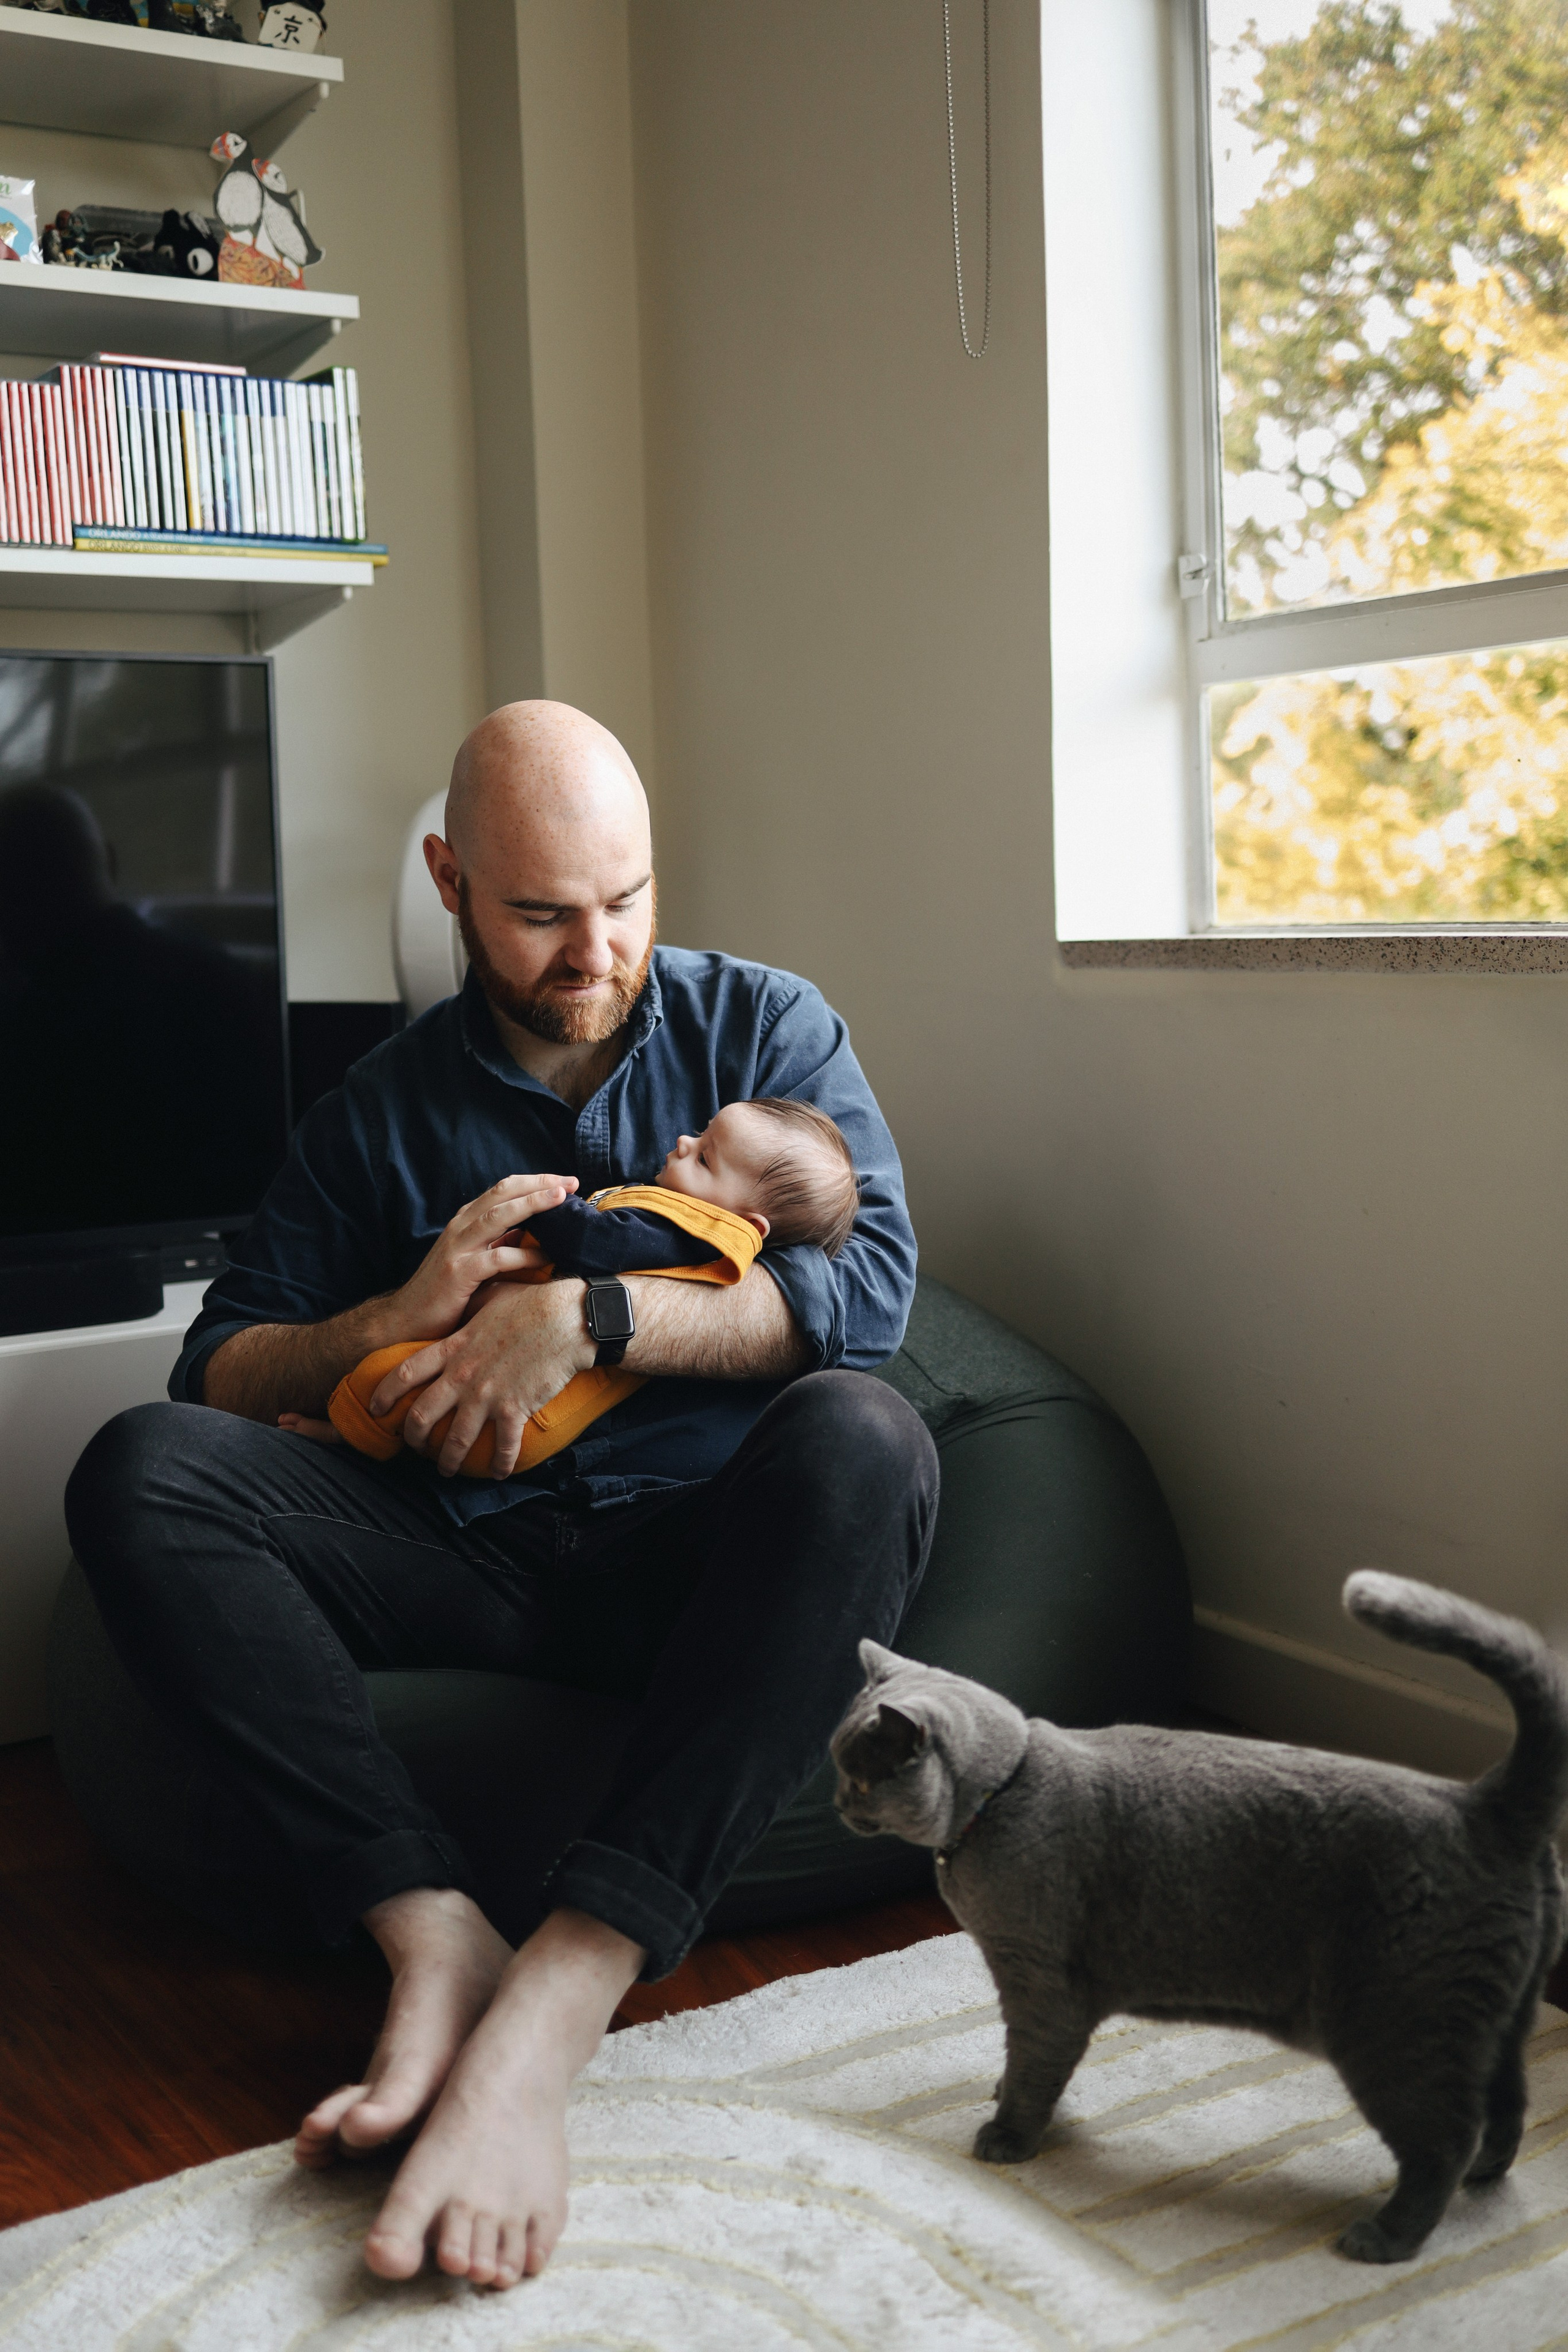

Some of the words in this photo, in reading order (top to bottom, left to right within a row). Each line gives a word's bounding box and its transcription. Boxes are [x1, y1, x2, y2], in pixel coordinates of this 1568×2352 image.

[274, 15, 303, 43] 京
[88, 528, 141, 540] ORLANDO
[88, 540, 141, 552] ORLANDO
